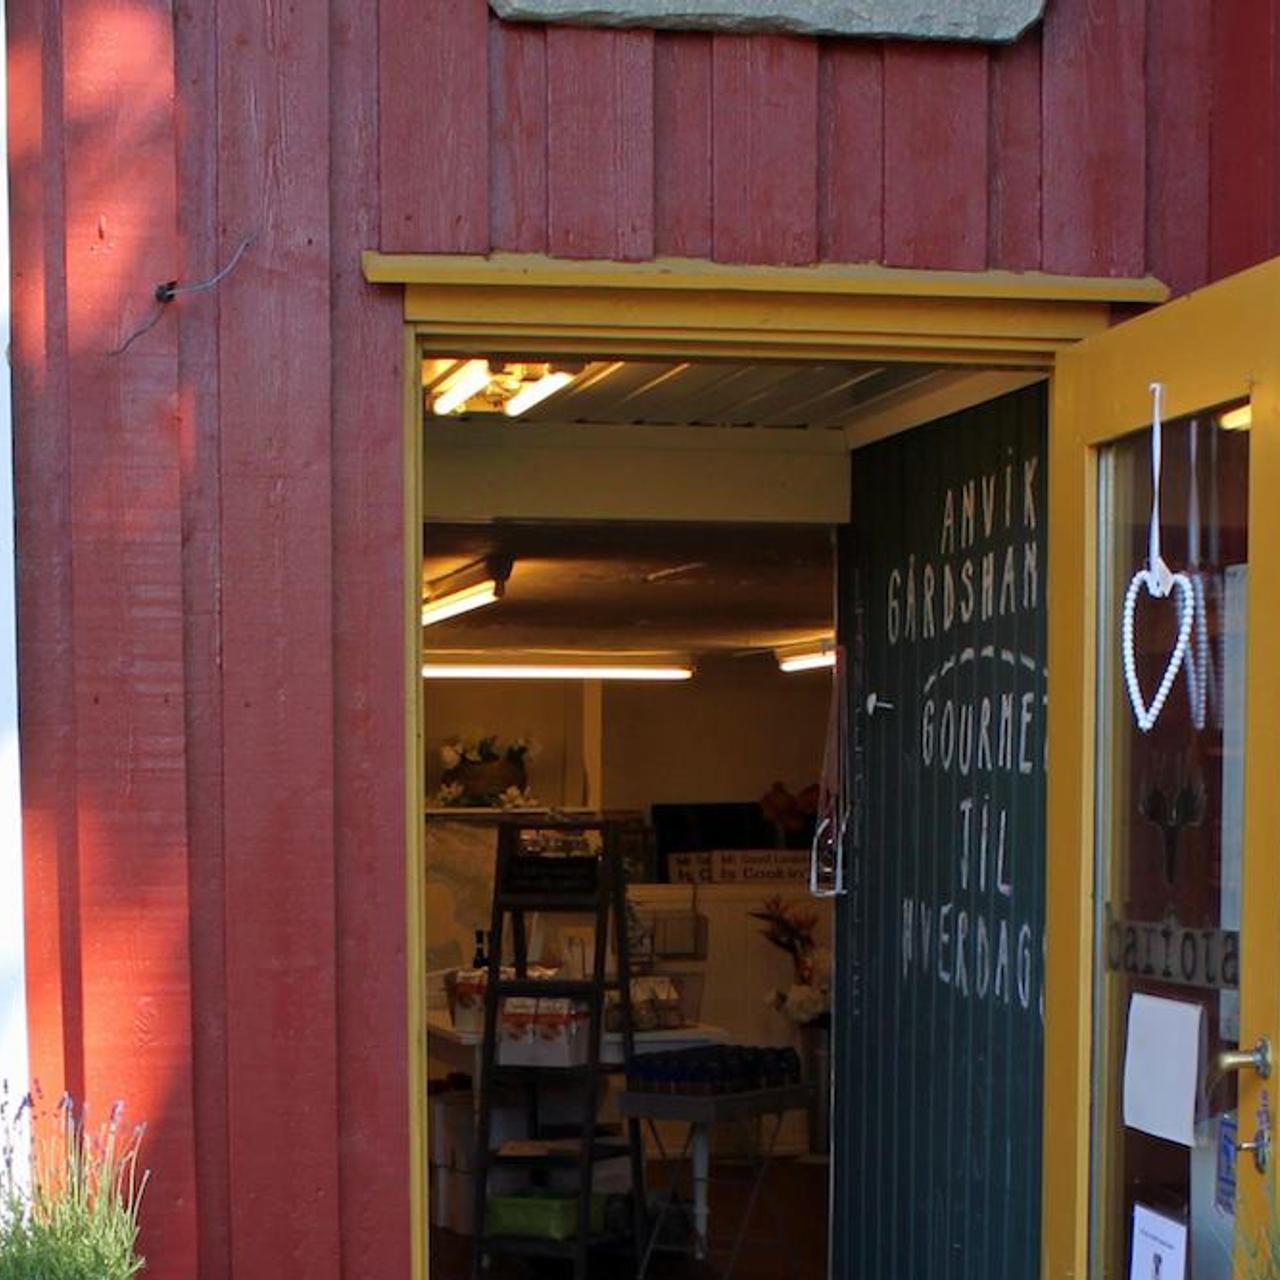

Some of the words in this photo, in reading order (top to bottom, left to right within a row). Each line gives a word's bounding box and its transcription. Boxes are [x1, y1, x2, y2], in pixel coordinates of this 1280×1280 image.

[940, 447, 1038, 554] ANVIK
[922, 692, 1048, 776] GOURME
[960, 794, 1011, 896] TIL
[902, 899, 1048, 1016] HVERDAG
